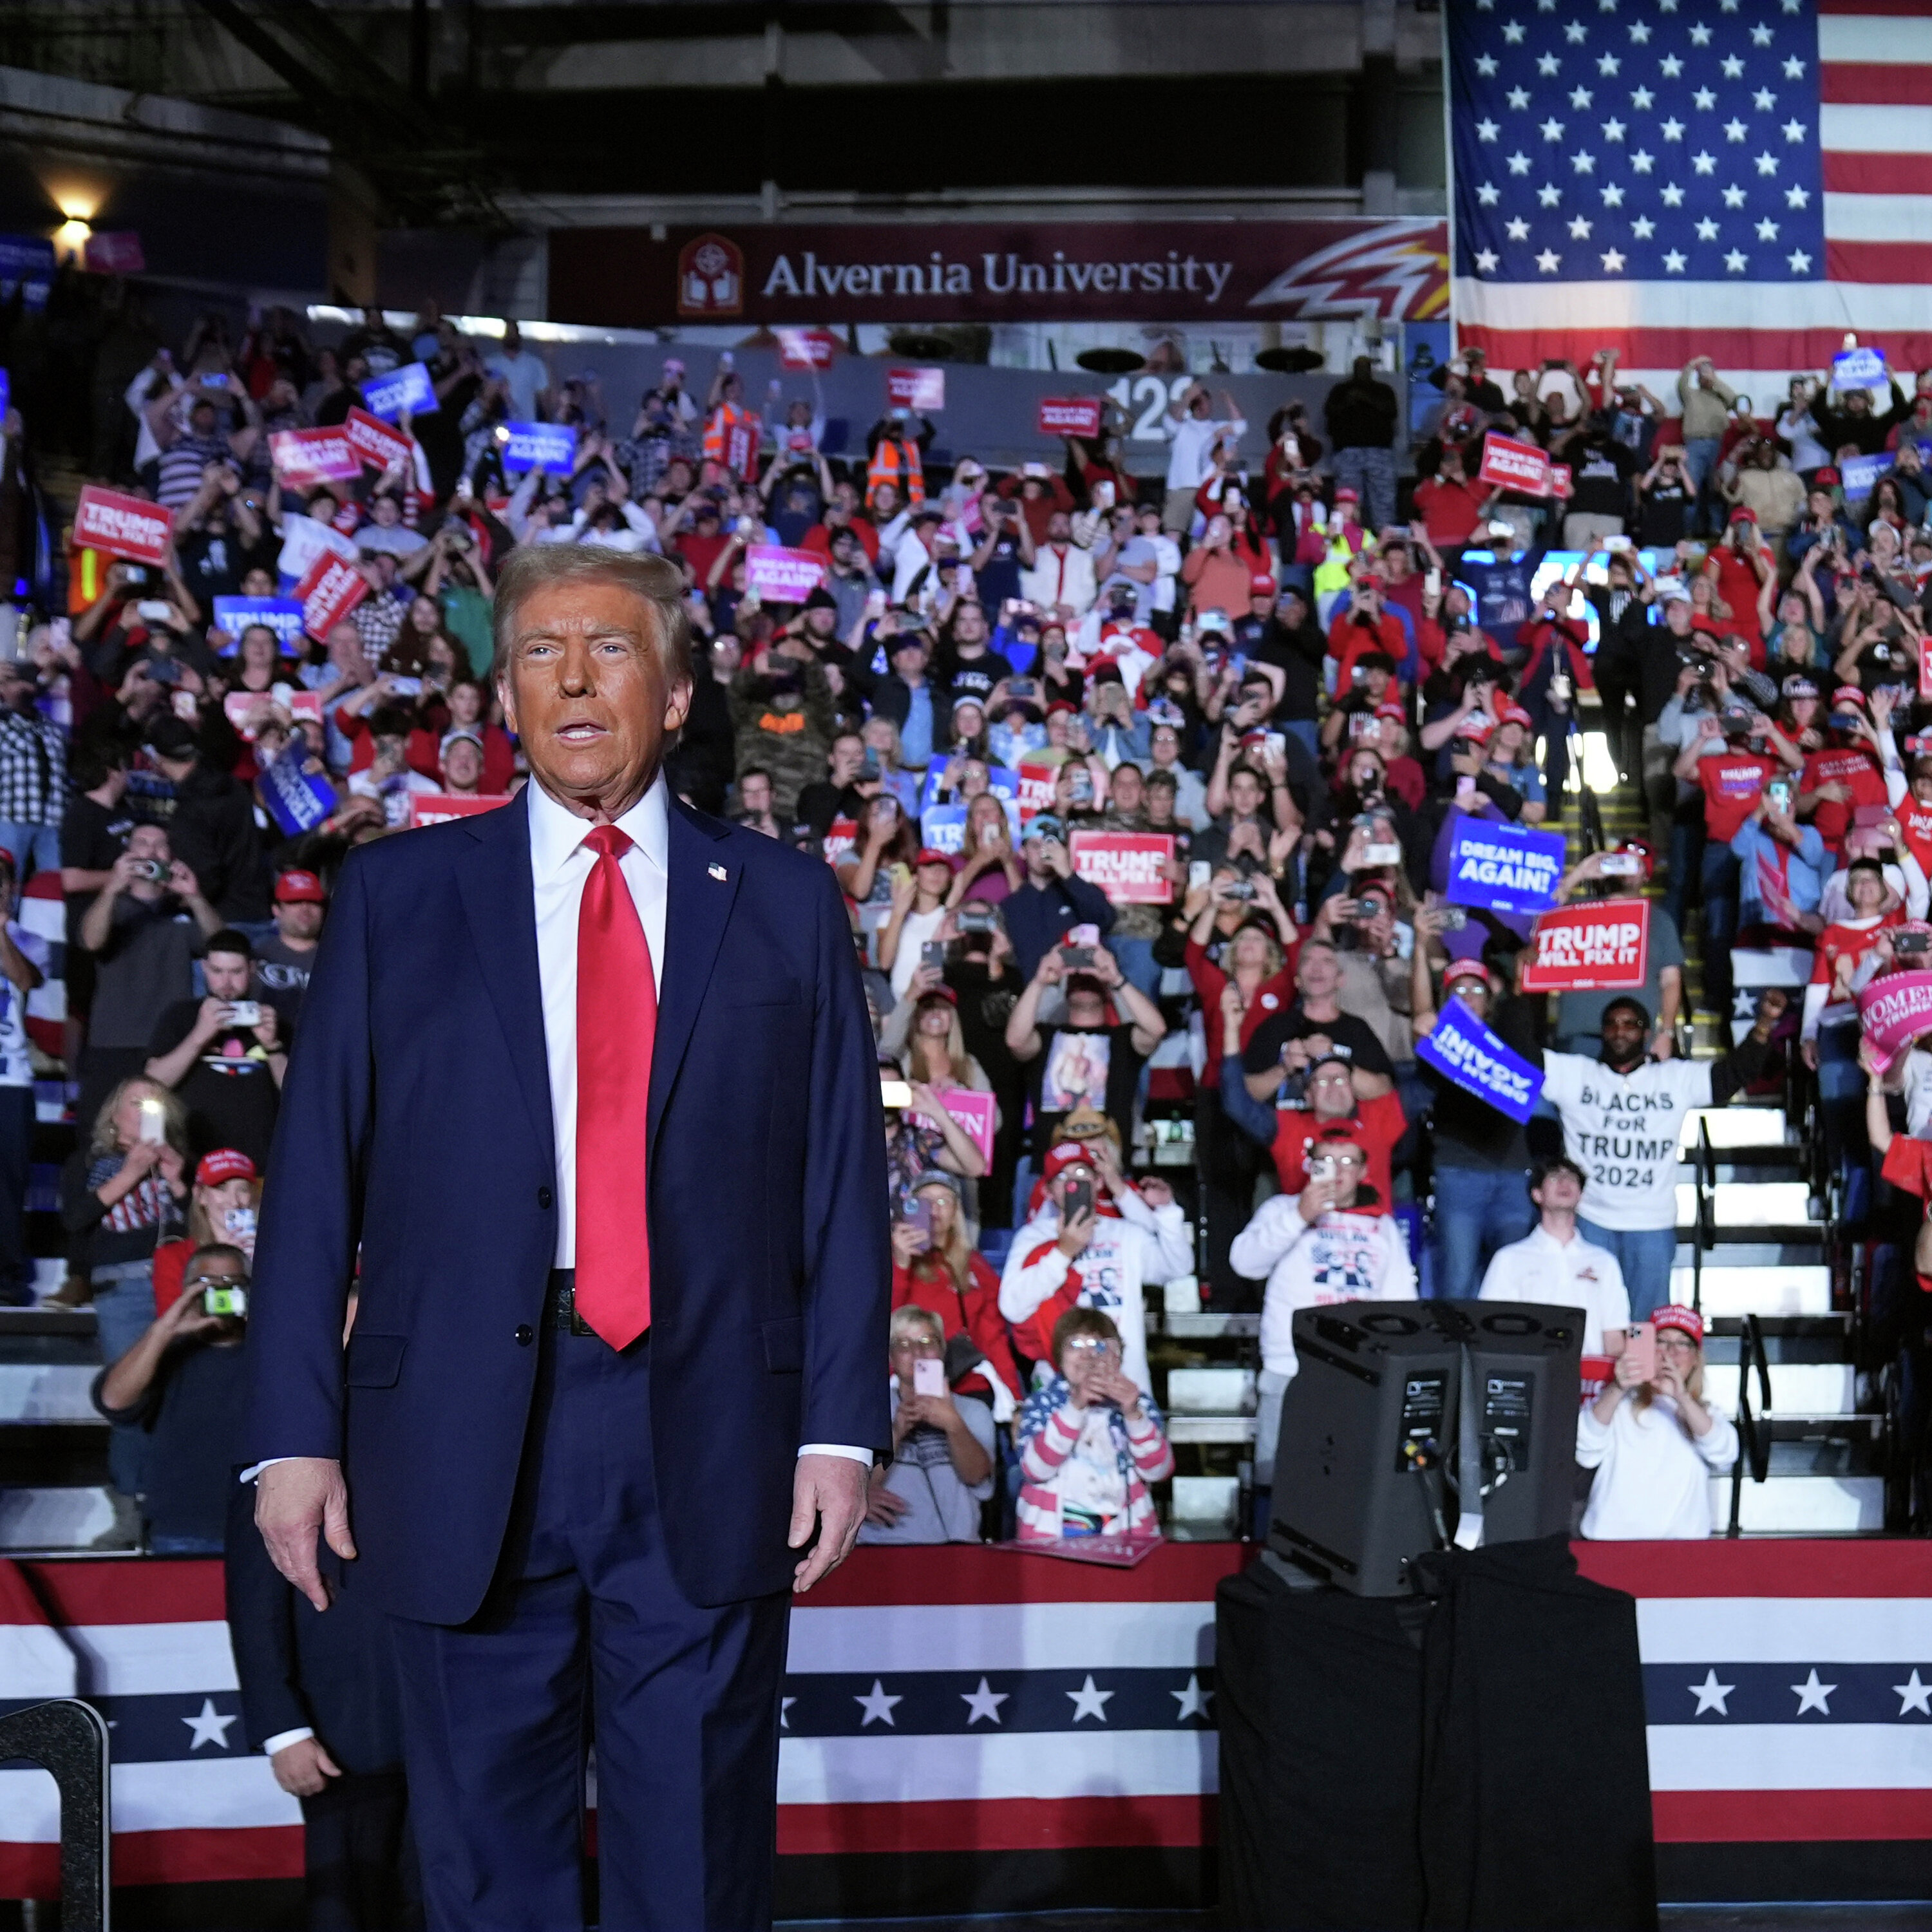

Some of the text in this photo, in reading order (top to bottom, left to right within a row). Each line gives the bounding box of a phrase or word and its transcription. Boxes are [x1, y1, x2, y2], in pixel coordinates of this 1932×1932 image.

[762, 250, 1234, 305] Alvernia University
[1107, 375, 1194, 440] 12
[84, 501, 168, 536] TRUMP
[1459, 839, 1524, 866] DREAM
[1458, 857, 1551, 894] AGAIN!
[1537, 922, 1641, 952] TRUMP
[1583, 948, 1616, 966] FIX
[1617, 946, 1639, 965] IT
[1580, 1085, 1674, 1112] BLACKS
[1603, 1115, 1647, 1132] FOR
[1578, 1132, 1674, 1160] TRUMP
[1593, 1164, 1654, 1188] 2024
